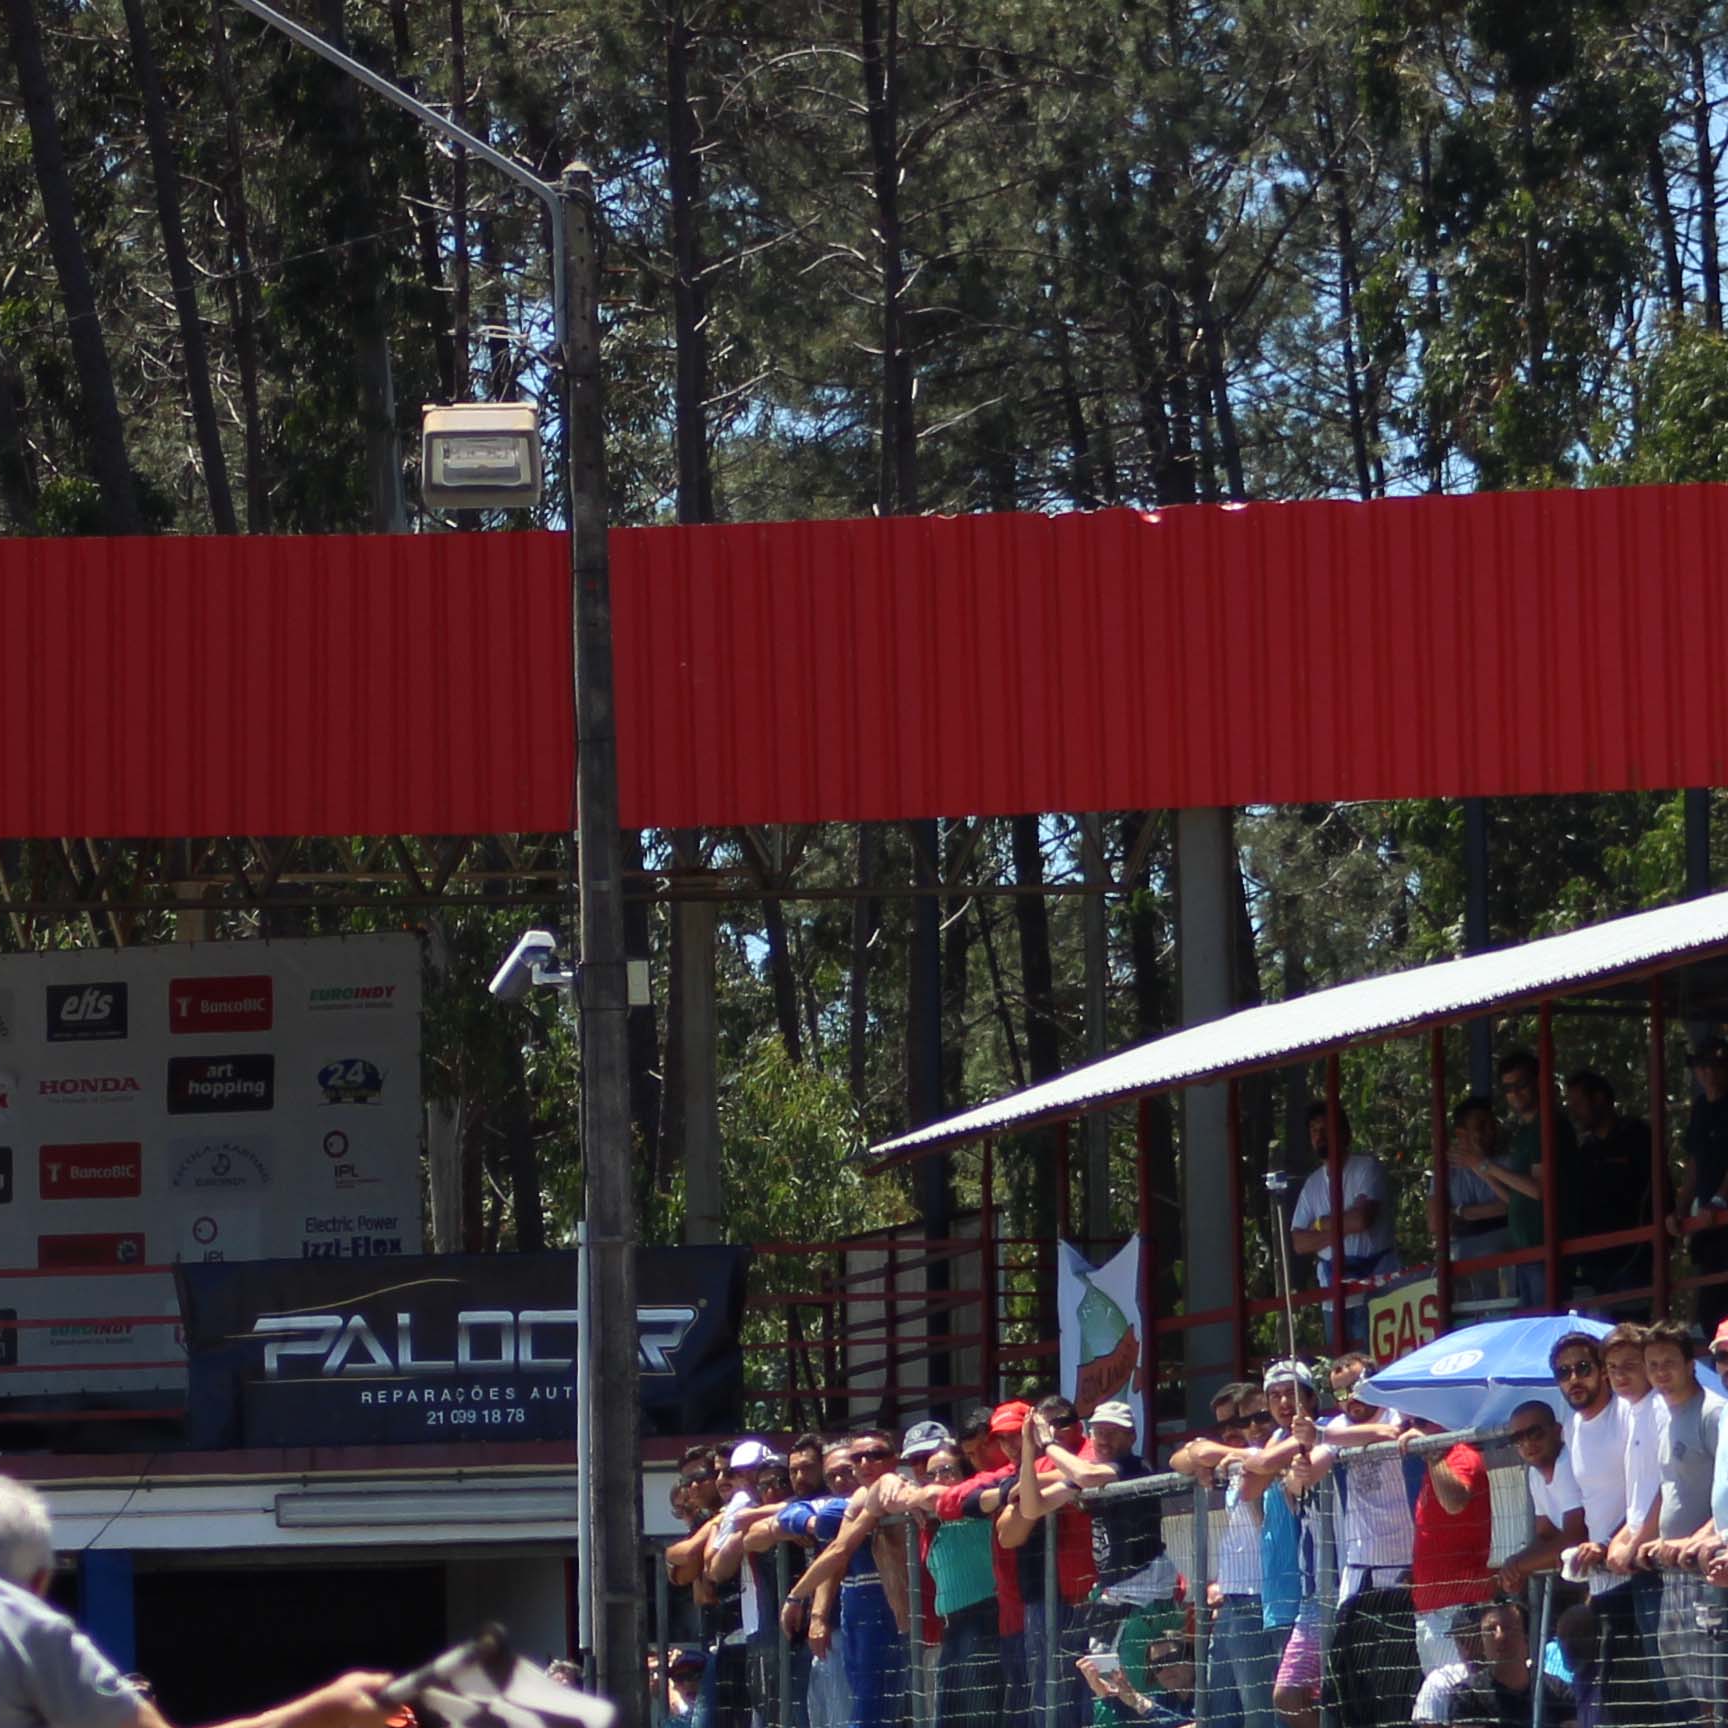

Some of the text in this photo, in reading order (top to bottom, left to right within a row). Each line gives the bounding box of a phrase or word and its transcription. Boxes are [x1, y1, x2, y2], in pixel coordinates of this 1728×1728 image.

[309, 984, 396, 1001] EUROINDY
[199, 997, 266, 1015] BancoBIC
[328, 1061, 366, 1085] 24
[39, 1076, 141, 1096] HONDA
[69, 1163, 136, 1179] BancoBIC
[334, 1163, 360, 1178] IPL
[304, 1215, 399, 1233] Electric Power
[1373, 1294, 1440, 1366] GAS
[252, 1308, 697, 1379] PALOCR
[361, 1385, 573, 1404] REPARAÇÕES AUT
[426, 1410, 444, 1425] 21
[482, 1409, 502, 1424] 18
[506, 1408, 525, 1423] 78
